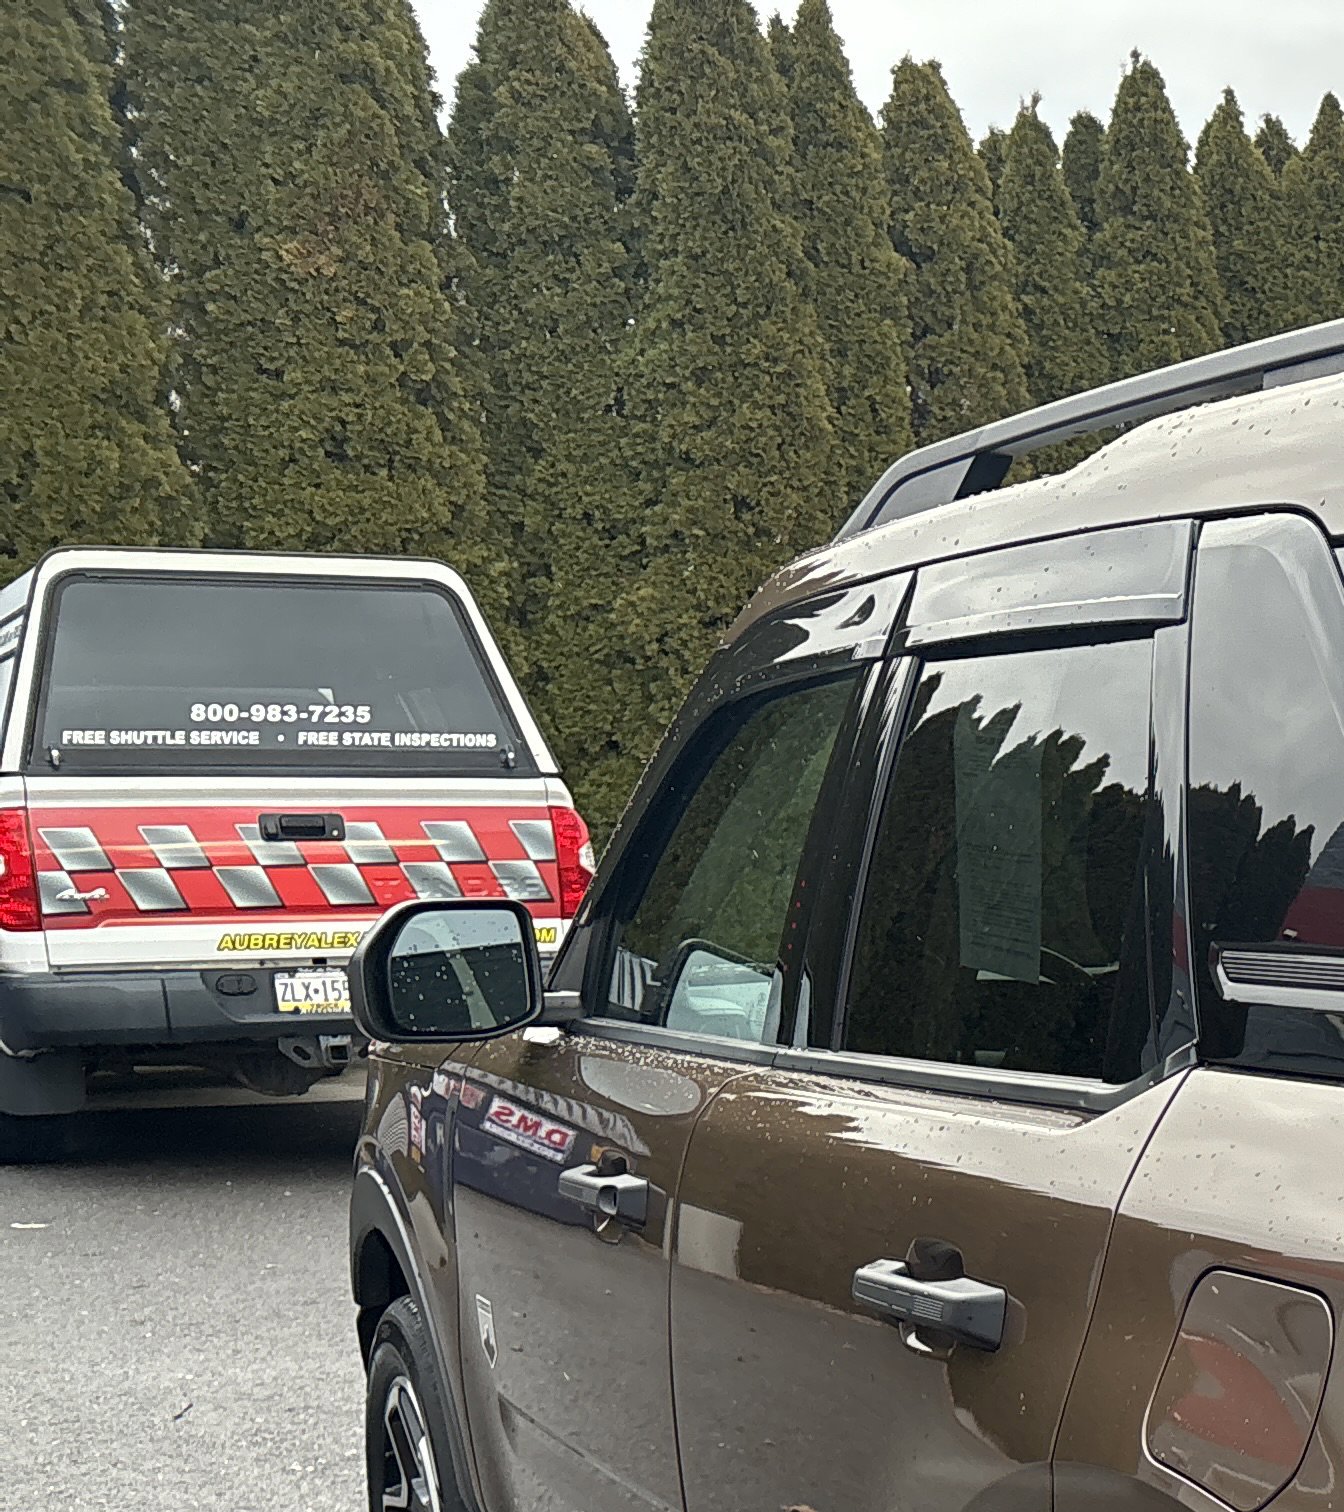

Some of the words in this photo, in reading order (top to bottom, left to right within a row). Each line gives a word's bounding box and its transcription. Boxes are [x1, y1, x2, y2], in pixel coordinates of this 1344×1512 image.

[190, 703, 371, 723] 800-983-7235
[62, 730, 106, 745] FREE
[109, 730, 186, 745] SHUTTLE
[189, 731, 260, 745] SERVICE
[298, 732, 338, 745] FREE
[342, 732, 392, 746] STATE
[394, 733, 497, 747] INSPECTIONS
